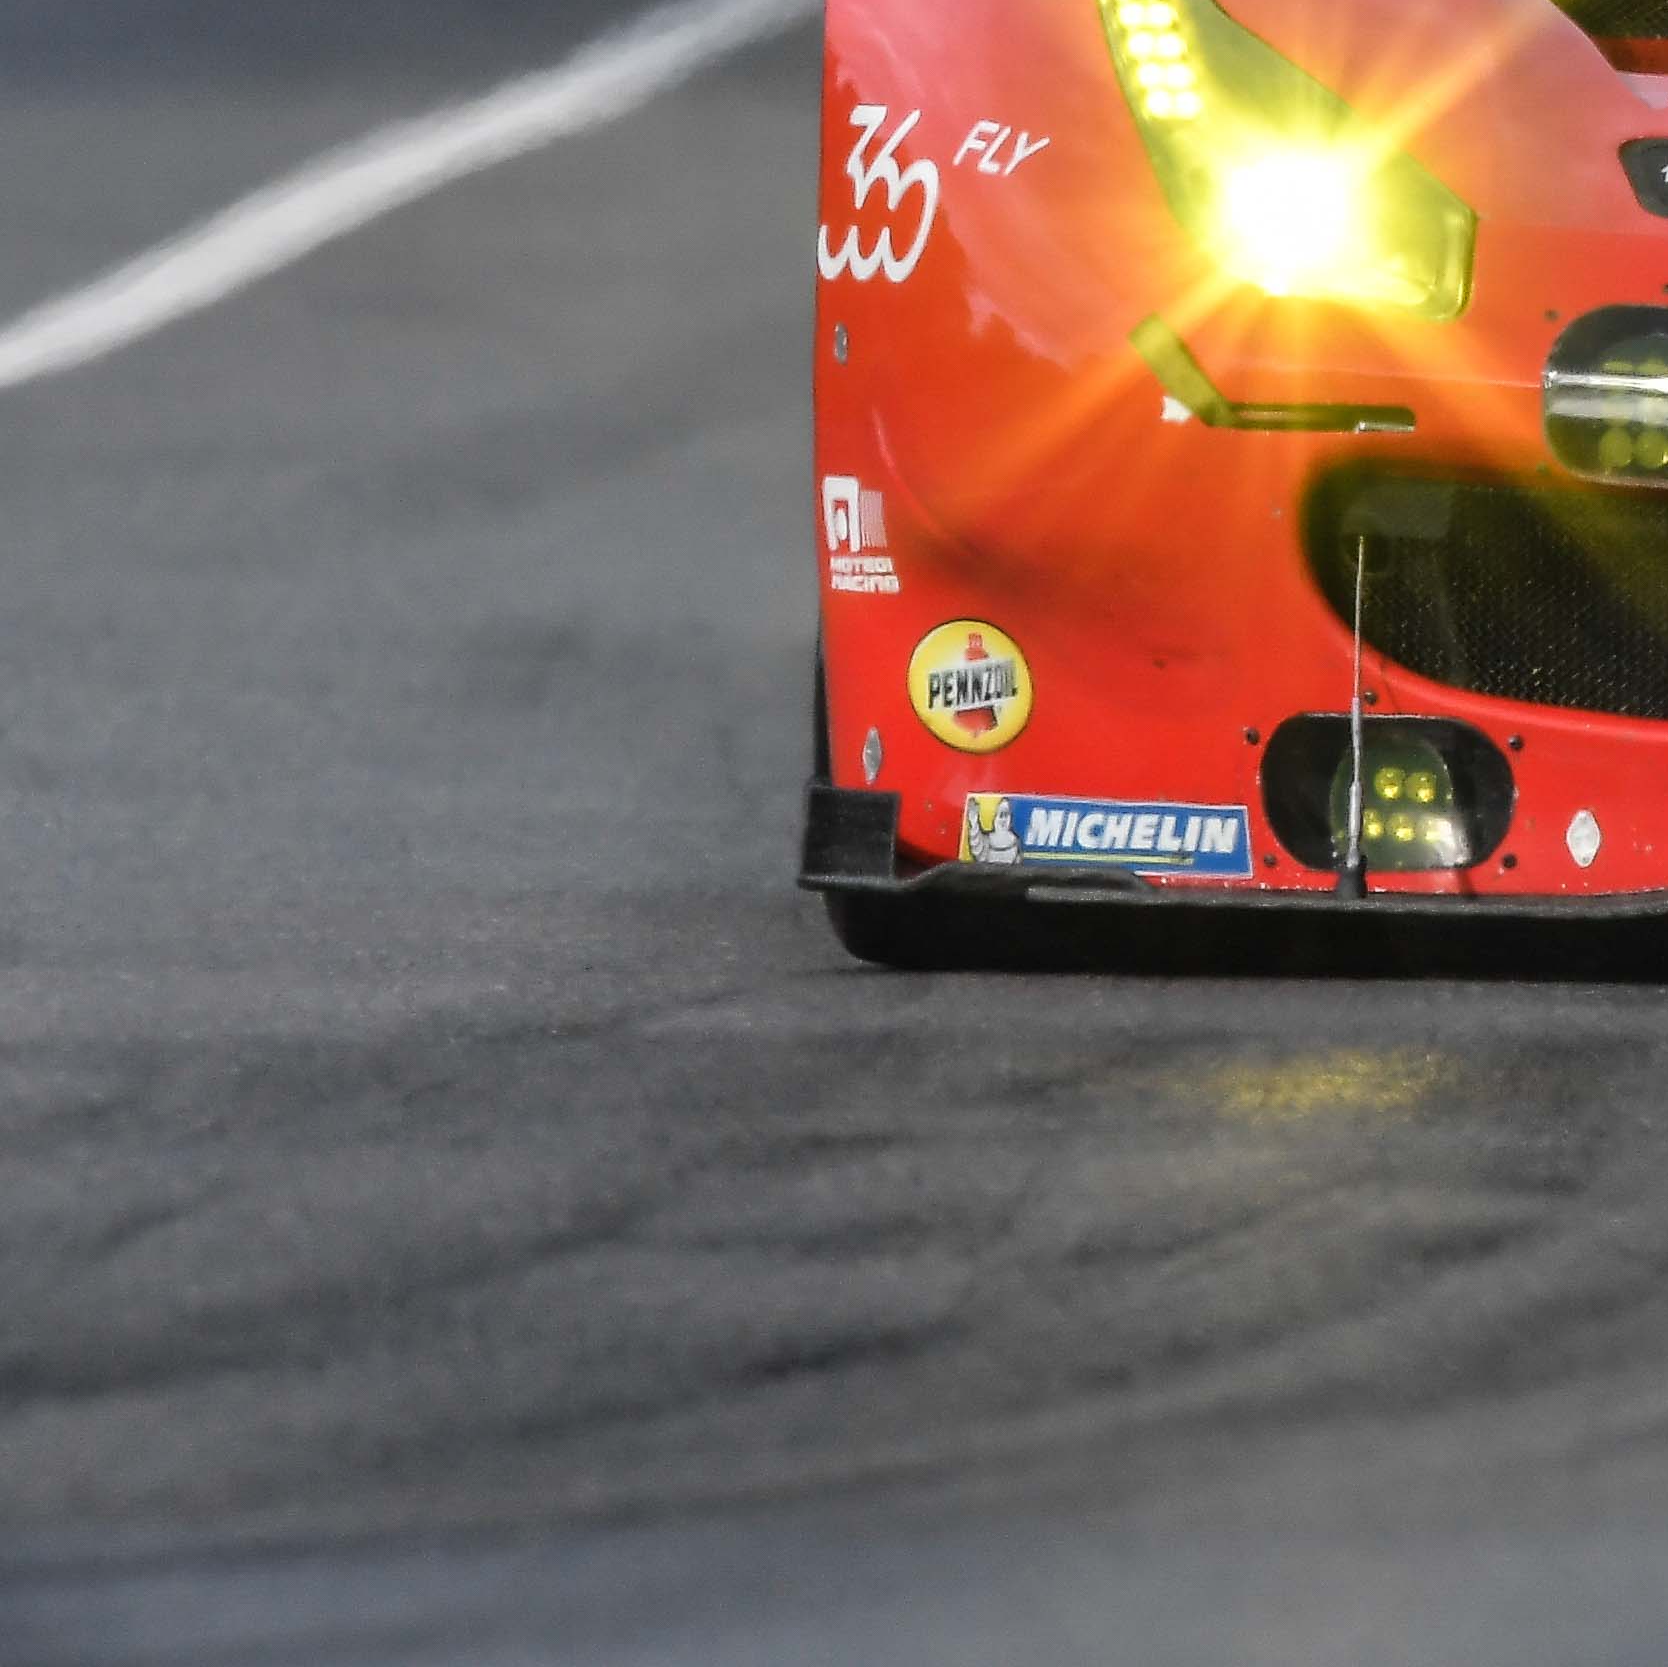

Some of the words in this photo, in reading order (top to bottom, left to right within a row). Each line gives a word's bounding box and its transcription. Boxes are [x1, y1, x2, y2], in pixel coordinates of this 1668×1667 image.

[953, 120, 1050, 176] FLY
[928, 660, 1019, 709] PENNZOIL
[1025, 807, 1238, 853] MICHELIN
